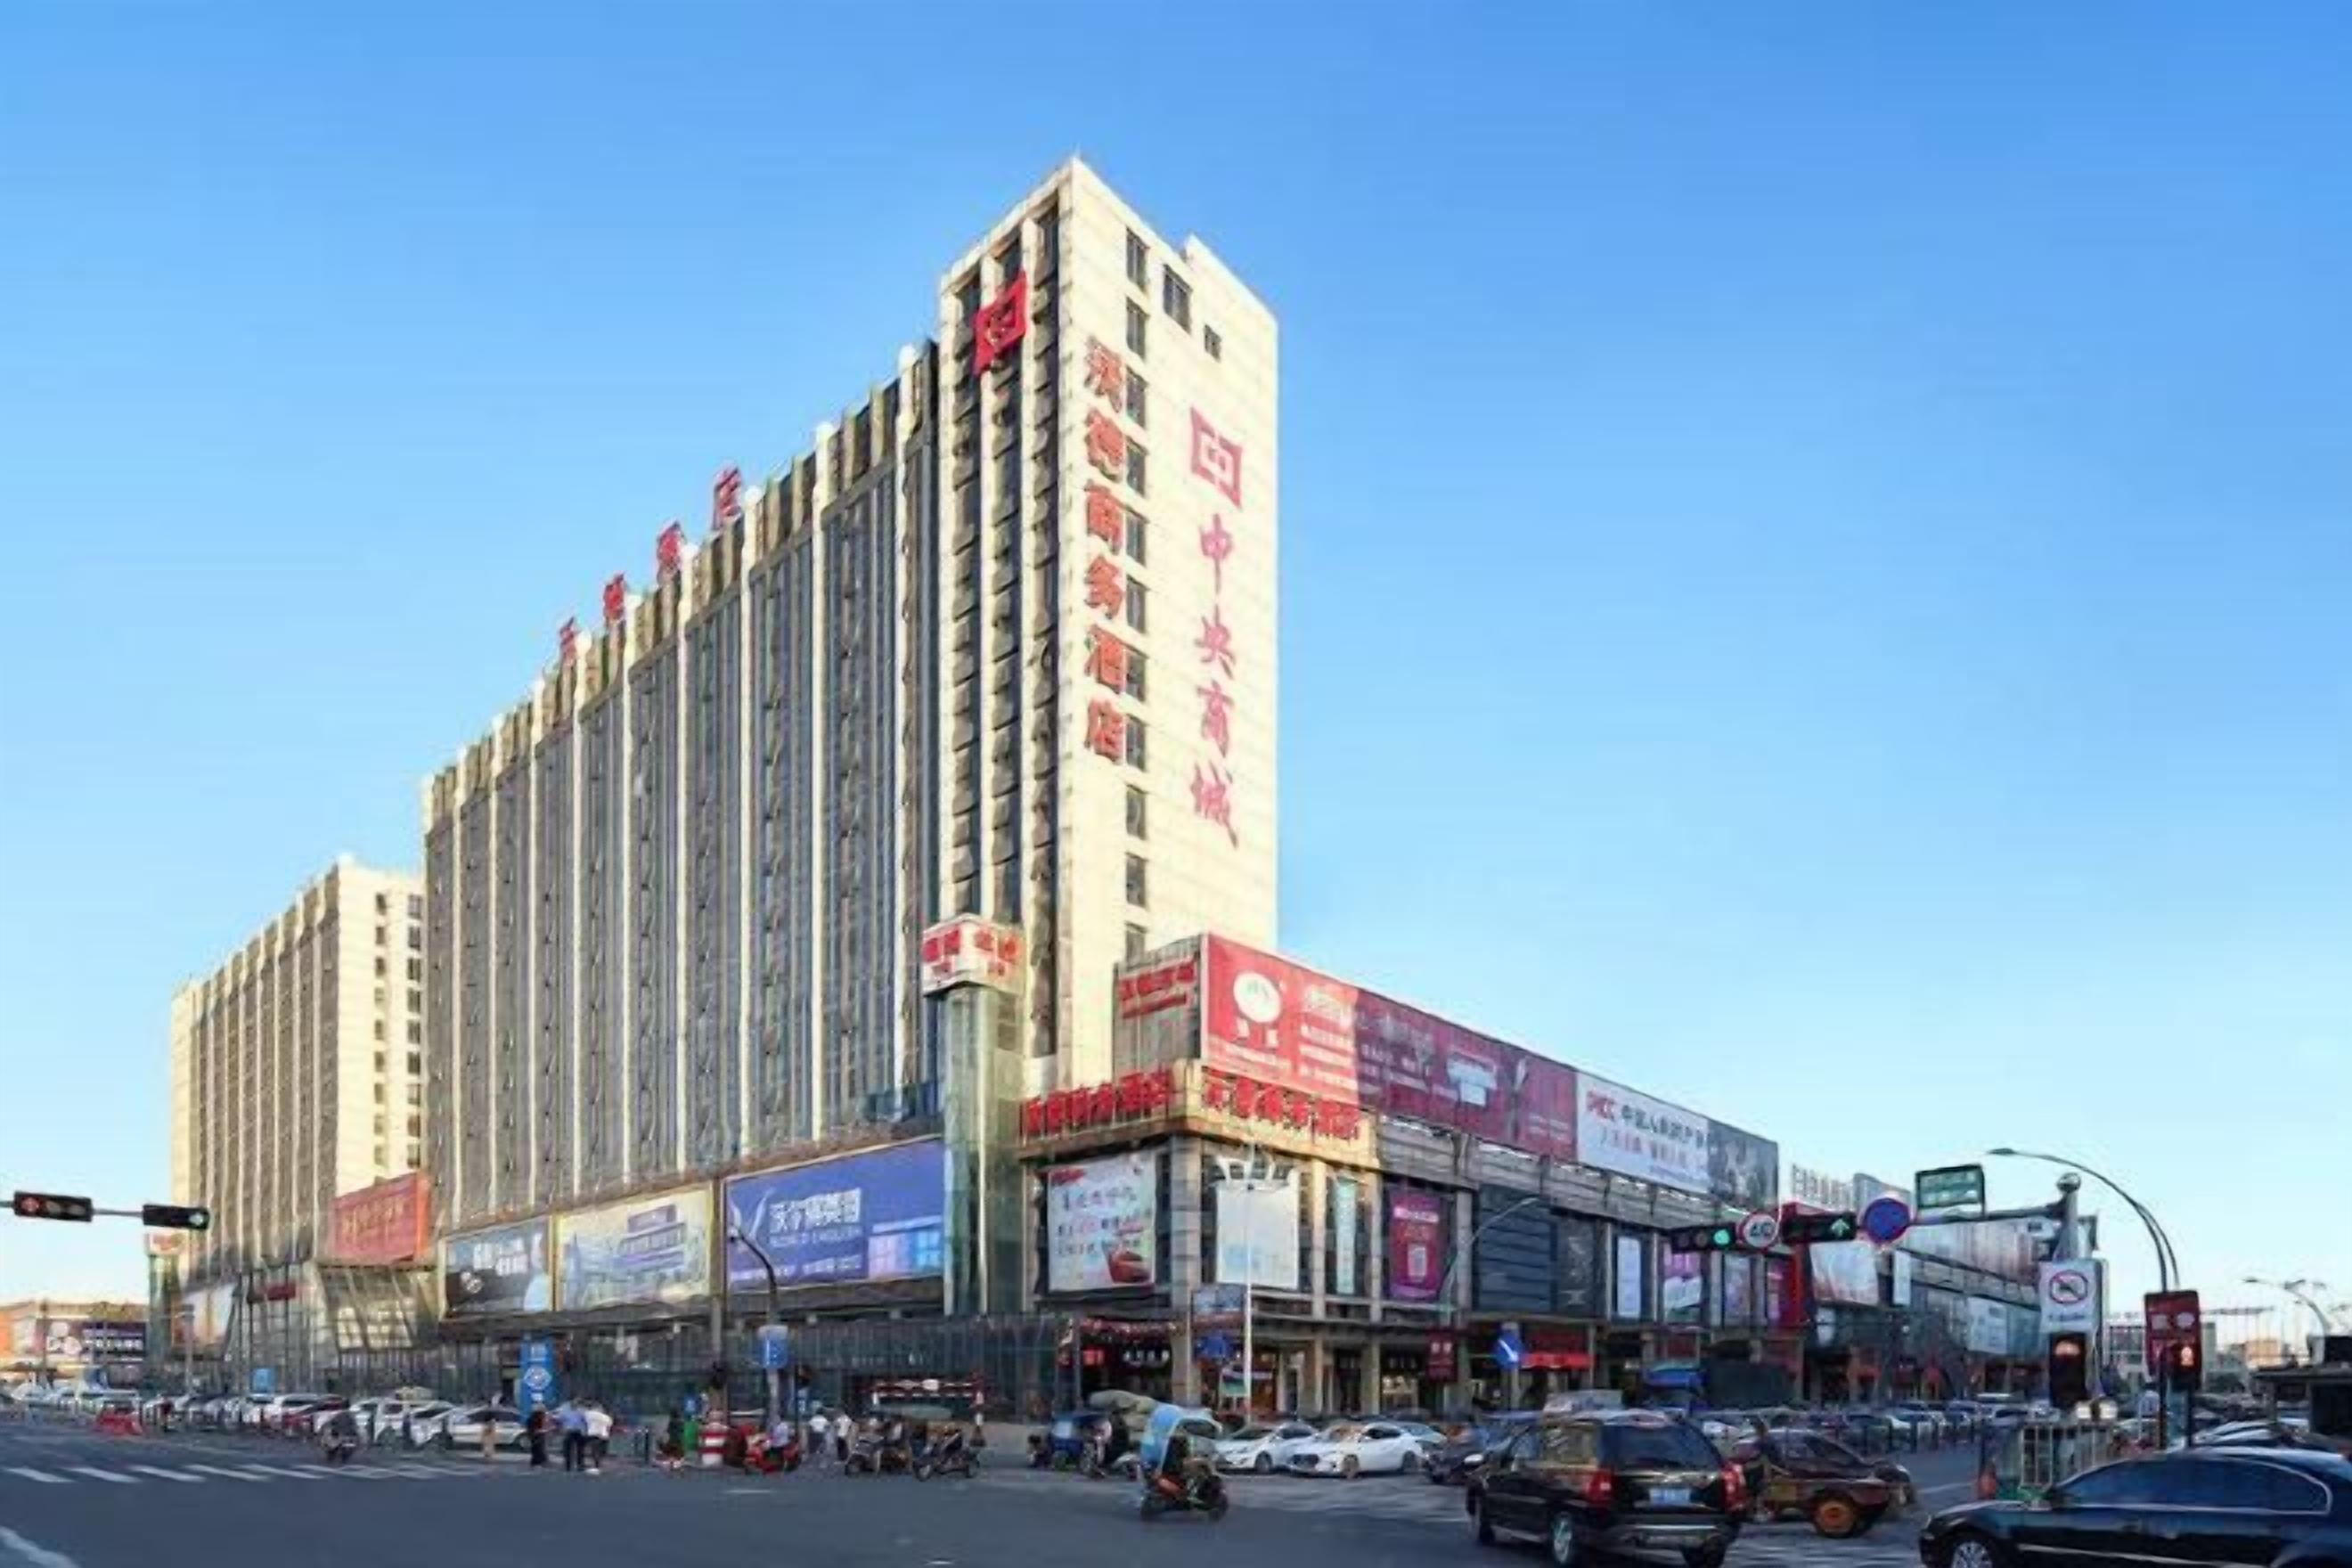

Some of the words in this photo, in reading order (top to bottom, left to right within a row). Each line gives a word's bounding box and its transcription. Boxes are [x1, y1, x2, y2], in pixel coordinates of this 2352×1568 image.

[1190, 511, 1238, 849] 中央商城
[1749, 1221, 1773, 1238] 40
